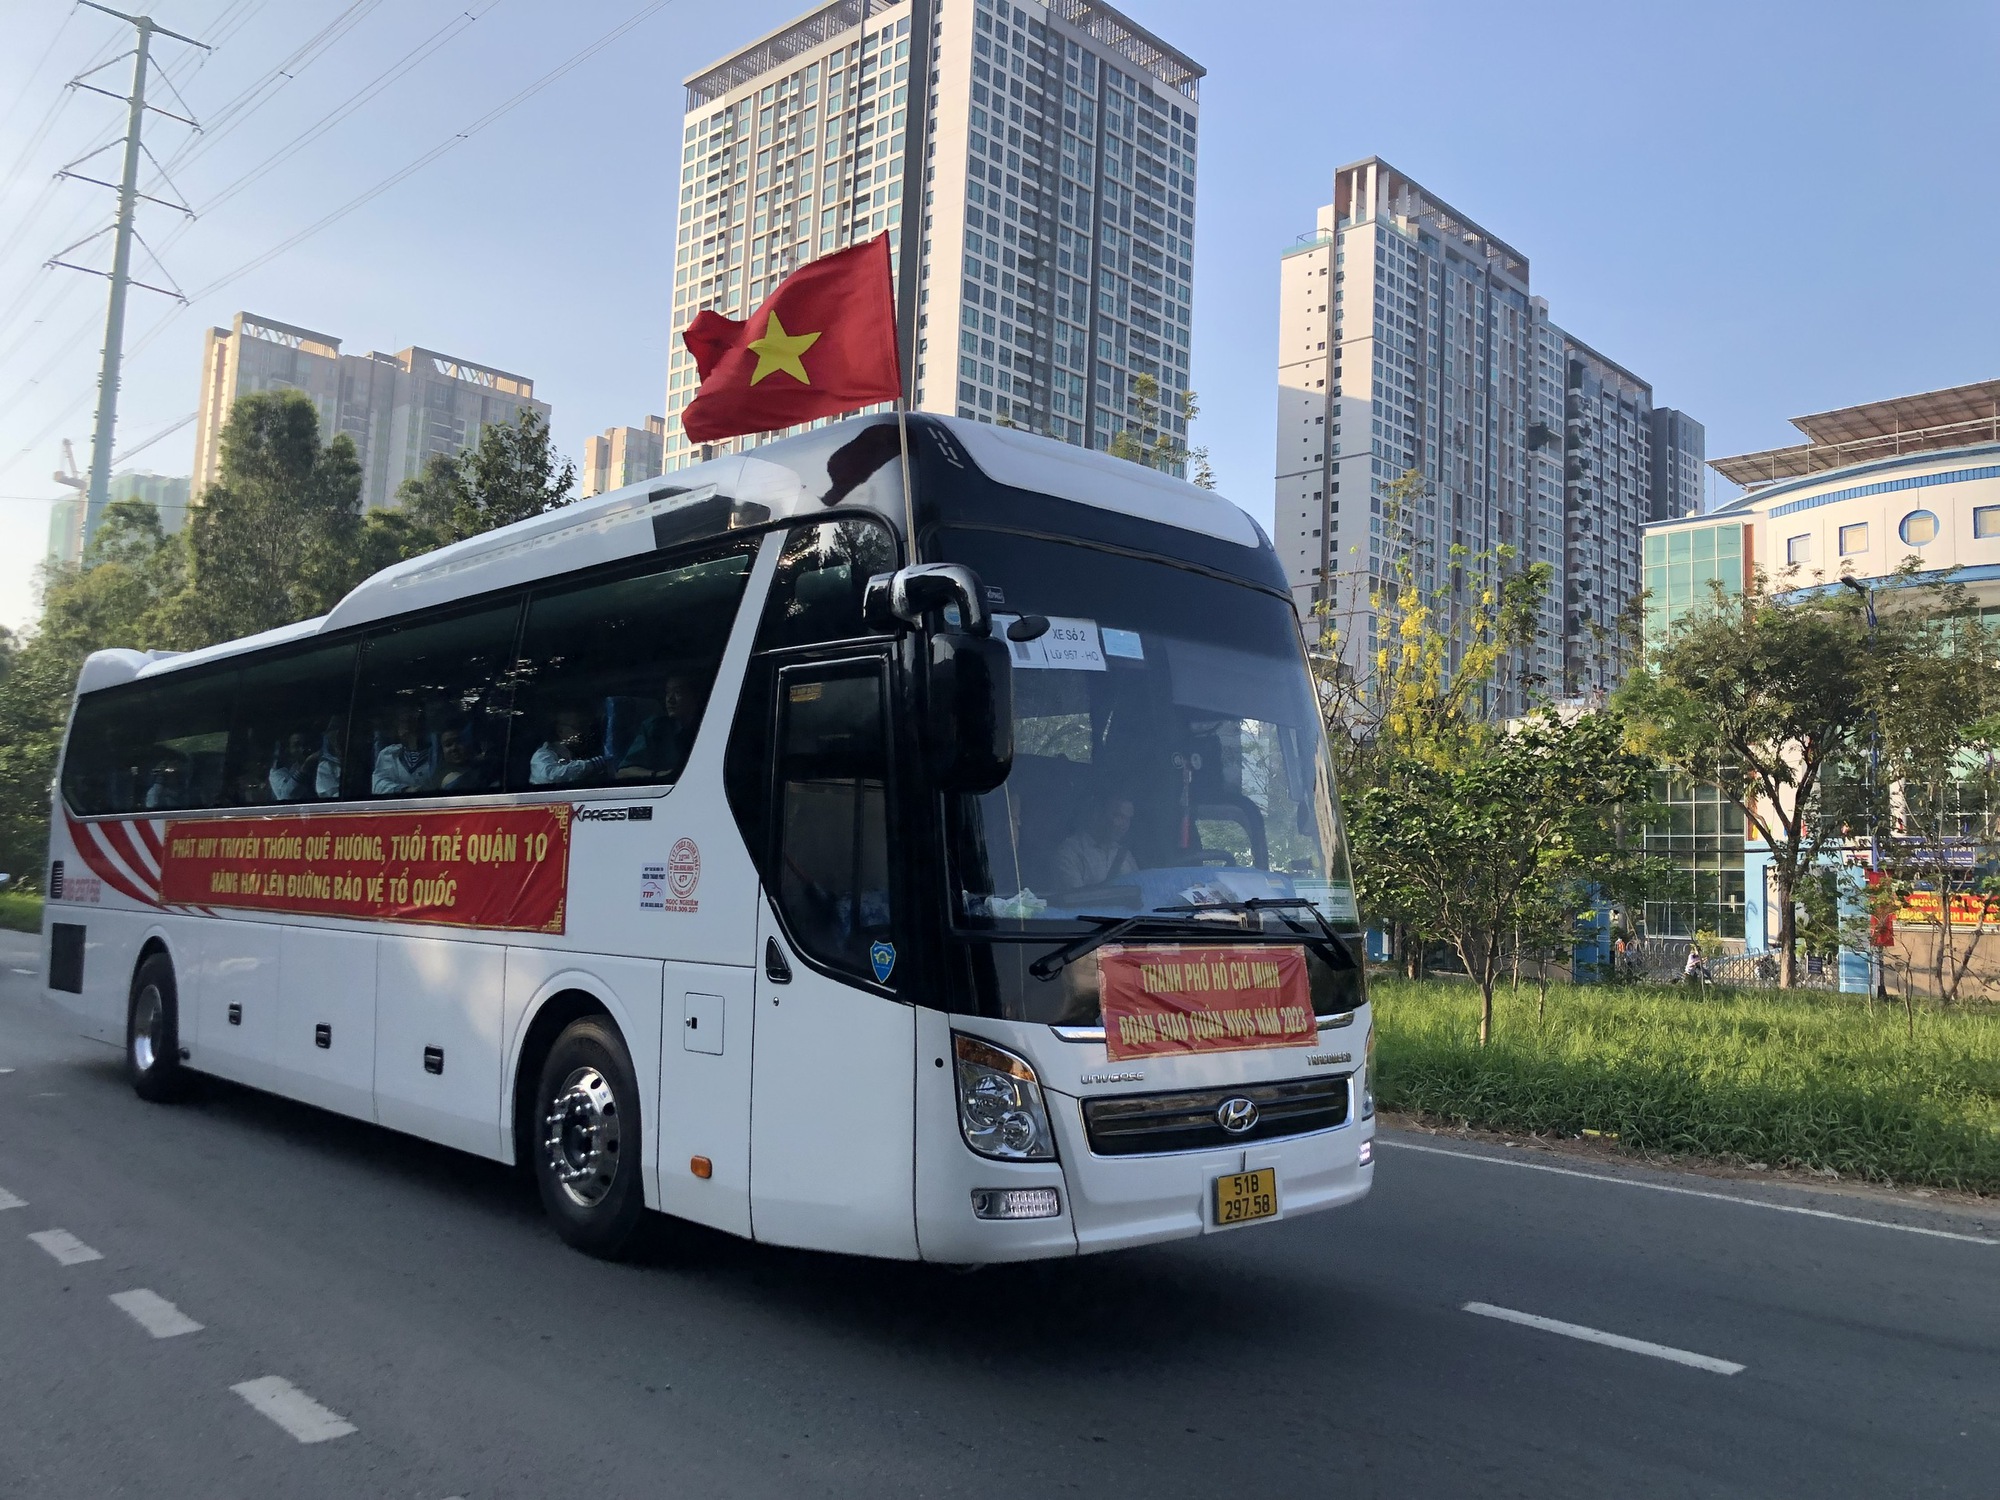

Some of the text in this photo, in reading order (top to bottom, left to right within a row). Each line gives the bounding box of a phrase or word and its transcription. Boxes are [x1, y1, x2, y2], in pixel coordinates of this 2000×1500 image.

[1052, 628, 1065, 640] XE
[1079, 630, 1086, 641] 2
[1063, 649, 1078, 660] 957
[1085, 650, 1099, 661] HQ
[172, 833, 196, 859] PHÁT
[197, 838, 218, 859] HUY
[263, 829, 302, 860] THỐNG
[305, 830, 331, 862] QUÊ
[333, 833, 386, 865] HƯƠNG,
[391, 824, 427, 861] TUỔI
[431, 827, 463, 861] TRẺ
[467, 827, 517, 869] QUẬN
[524, 832, 548, 862] 10
[240, 868, 262, 895] HÁI
[262, 868, 285, 897] LÊN
[287, 869, 331, 899] ĐƯỜNG
[333, 870, 363, 901] BẢO
[366, 871, 385, 908] VỆ
[389, 867, 409, 904] TỔ
[412, 870, 457, 908] QUỐC
[1141, 953, 1281, 993] THÀNH PHỐ HỒ CHÍ MINH
[1118, 1007, 1157, 1046] ĐOÀN
[1157, 1011, 1189, 1042] GIAO
[1190, 1003, 1224, 1042] QUÂN
[1254, 1002, 1282, 1035] NĂM
[1280, 1006, 1308, 1033] 2023
[1233, 1173, 1259, 1196] 51B
[1224, 1193, 1271, 1221] 297.58
